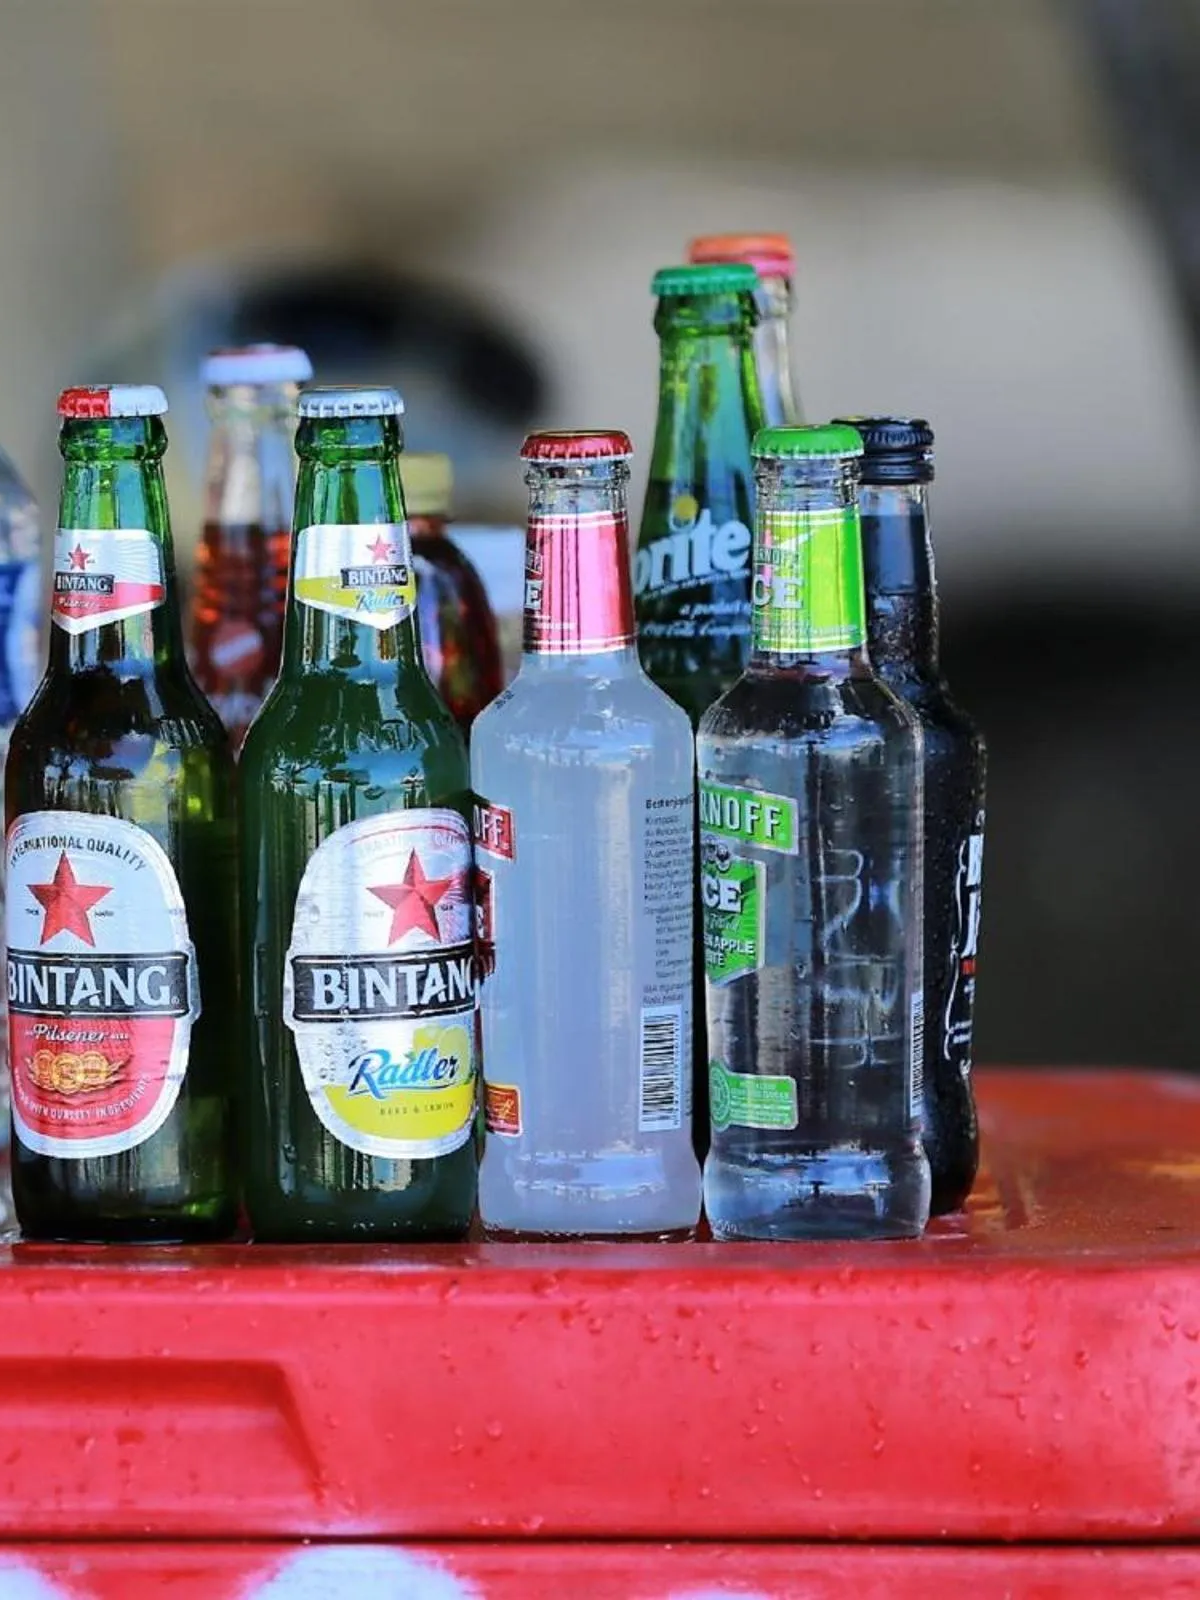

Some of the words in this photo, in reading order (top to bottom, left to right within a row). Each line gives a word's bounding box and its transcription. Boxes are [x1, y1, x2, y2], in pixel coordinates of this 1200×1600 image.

[348, 568, 407, 585] BINTANG
[86, 838, 147, 871] QUALITY
[8, 965, 170, 1007] BINTANG
[33, 1023, 108, 1043] Pilsener
[348, 1048, 460, 1099] Radler
